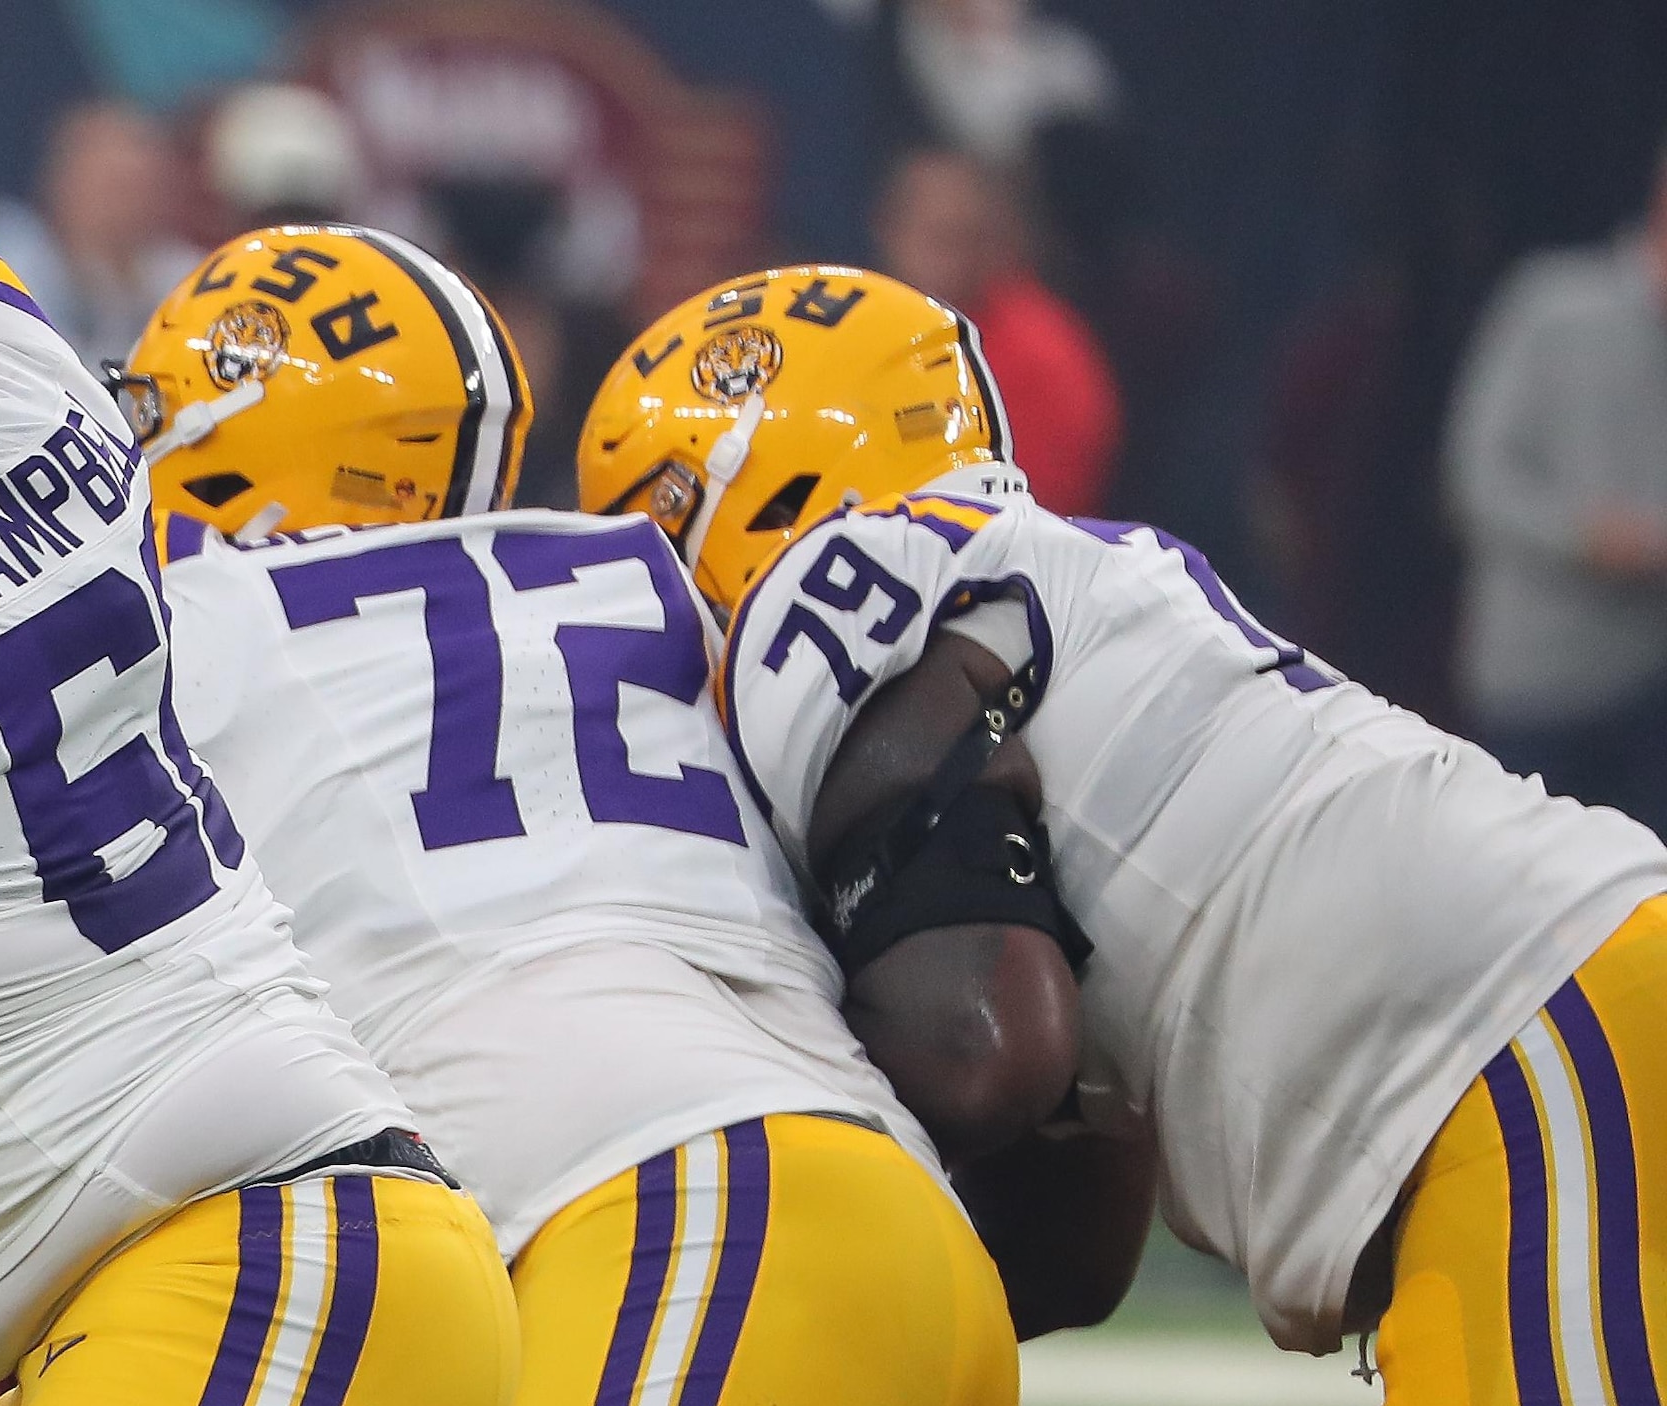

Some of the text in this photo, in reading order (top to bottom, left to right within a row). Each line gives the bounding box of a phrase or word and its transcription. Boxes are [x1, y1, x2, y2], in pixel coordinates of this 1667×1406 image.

[192, 248, 400, 361] LSU
[267, 516, 750, 851] 72
[761, 534, 923, 709] 79
